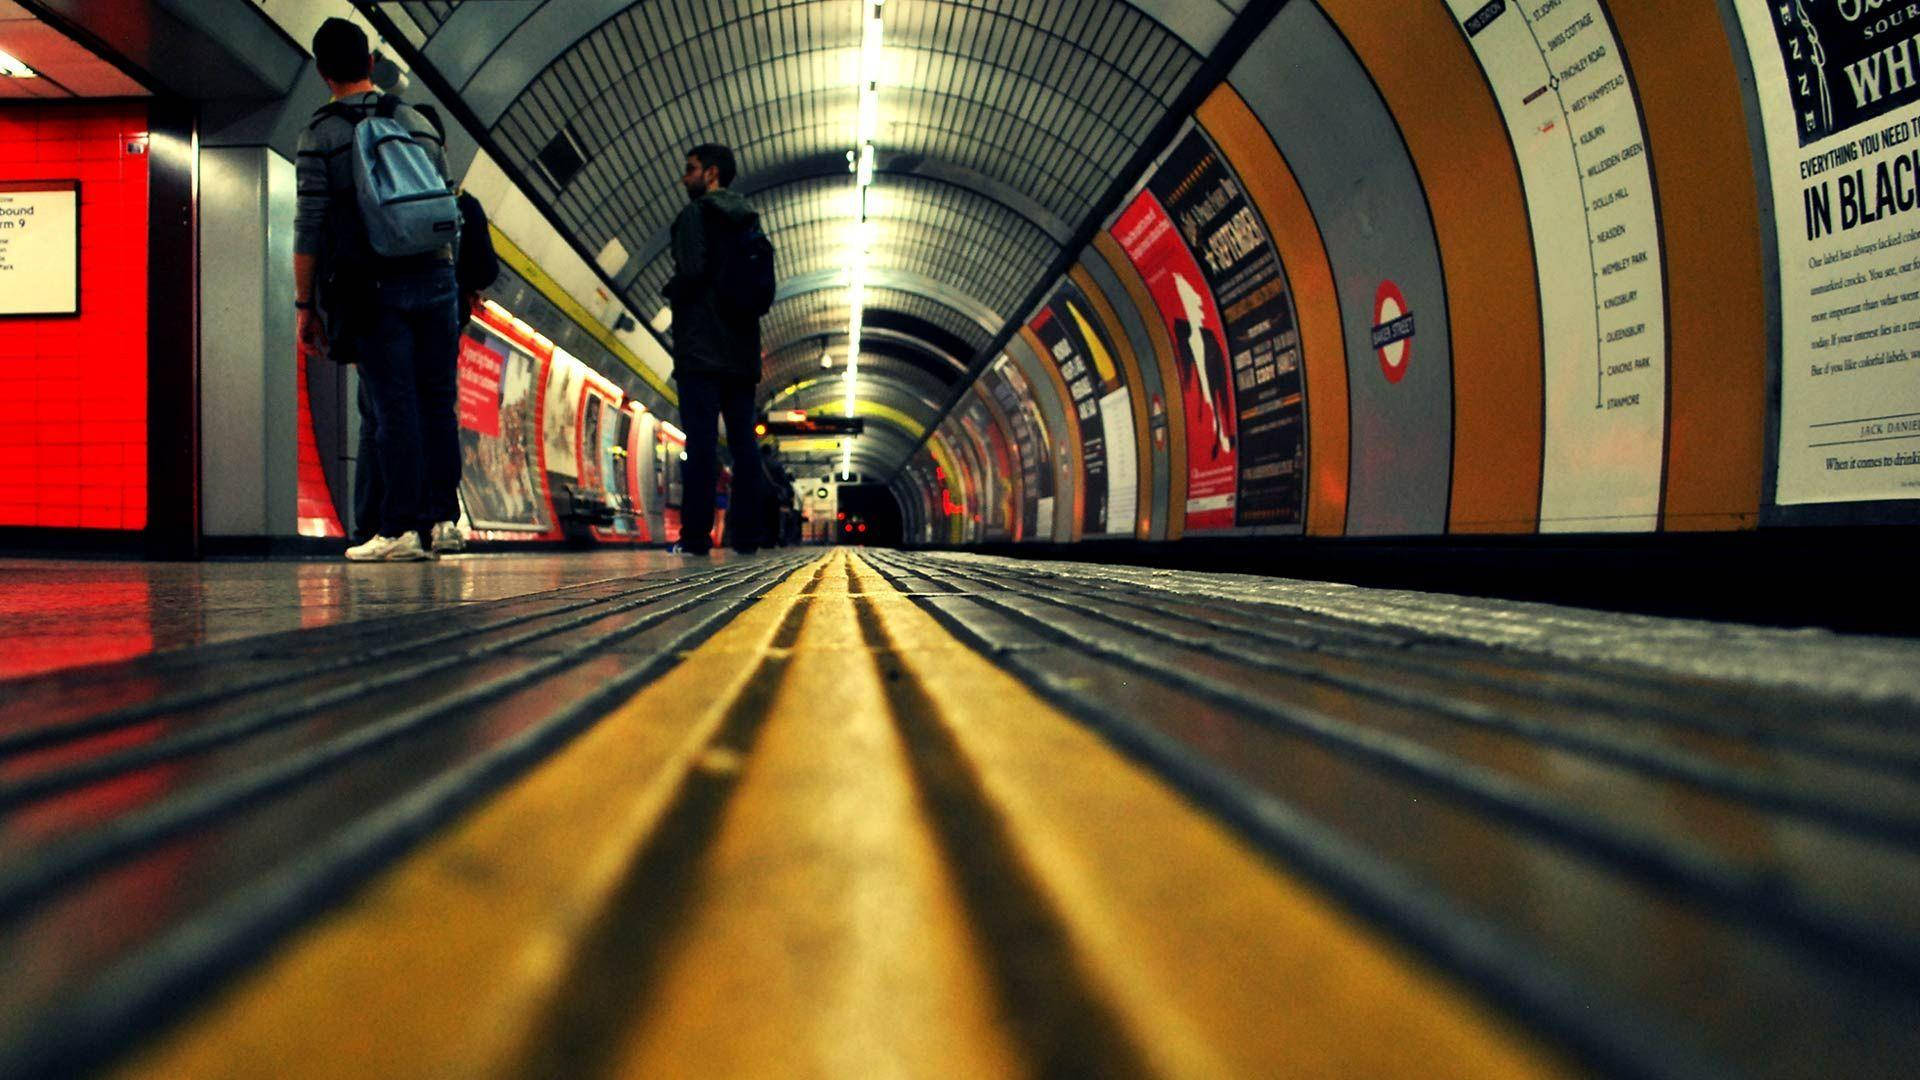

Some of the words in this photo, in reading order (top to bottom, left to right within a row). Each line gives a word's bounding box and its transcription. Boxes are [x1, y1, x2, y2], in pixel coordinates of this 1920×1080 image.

[1565, 12, 1593, 40] COTTAGE
[1863, 4, 1920, 40] SOUR
[1560, 57, 1588, 81] FINCHLEY
[1588, 45, 1607, 66] ROAD
[1571, 96, 1588, 113] WEST
[1587, 74, 1625, 102] HAMPSTEAD
[1580, 124, 1606, 146] KILBURN
[1587, 155, 1621, 177] WILLESDEN
[1621, 142, 1643, 161] GREEN
[1800, 141, 1859, 180] EVERYTHING
[1859, 133, 1880, 157] YOU
[1881, 122, 1909, 149] NEED
[1592, 193, 1614, 211] DOLLIS
[1614, 186, 1629, 202] HILL
[1804, 181, 1832, 241] IN
[19, 218, 26, 228] 9
[1597, 225, 1626, 243] NEASDEN
[1808, 256, 1822, 269] Our
[1840, 249, 1853, 261] has
[1853, 244, 1878, 256] always
[1878, 231, 1902, 250] lacked
[1602, 257, 1630, 276] WEMBLEY
[1631, 251, 1648, 267] PARK
[1869, 268, 1883, 281] You
[1604, 290, 1638, 309] KINGSBURY
[1829, 304, 1861, 321] important
[1606, 323, 1645, 343] QUEENSBURY
[1607, 360, 1633, 376] CANONS
[1634, 356, 1650, 370] PARK
[1811, 364, 1823, 377] But
[1830, 363, 1843, 376] you
[1858, 353, 1885, 369] colorful
[1606, 394, 1640, 410] STANMORE
[1861, 425, 1883, 438] JACK
[1826, 457, 1848, 471] When
[1849, 456, 1856, 469] it
[1857, 458, 1882, 469] comes
[1883, 456, 1893, 467] to
